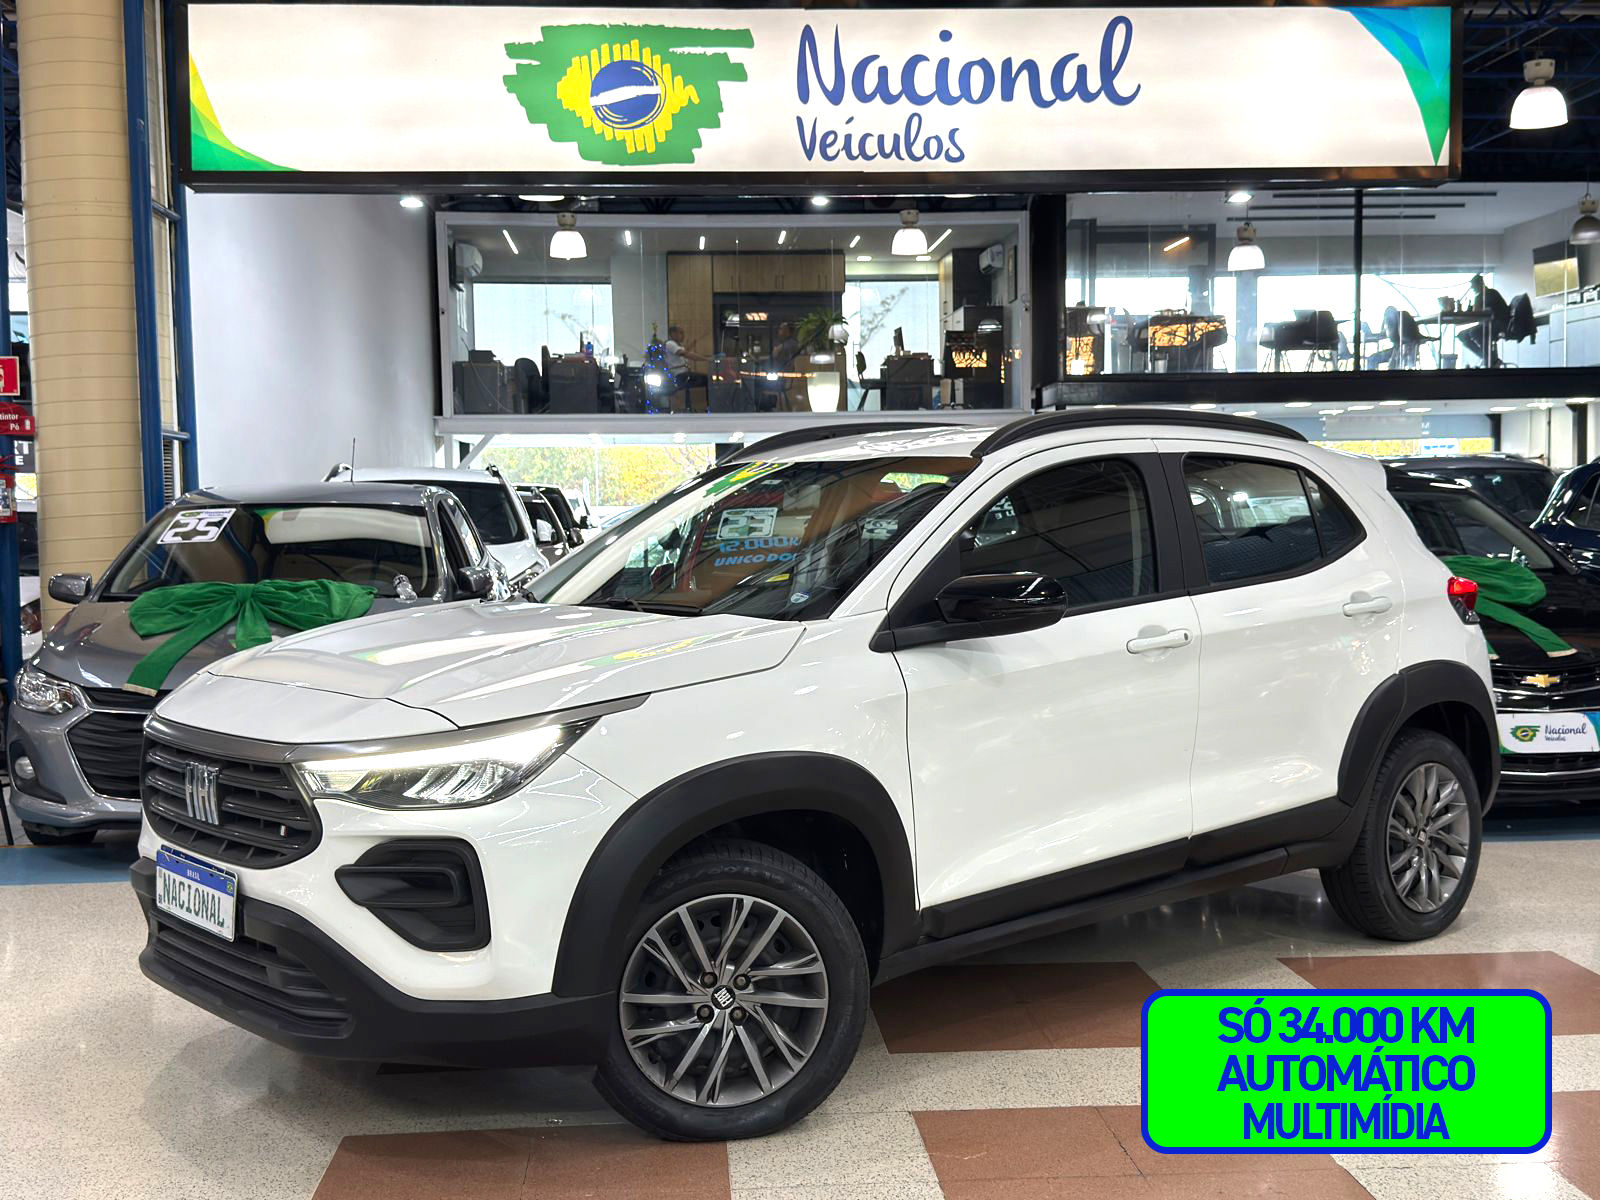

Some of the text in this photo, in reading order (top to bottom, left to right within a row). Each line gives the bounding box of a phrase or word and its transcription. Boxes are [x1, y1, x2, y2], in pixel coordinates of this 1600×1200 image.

[797, 15, 1141, 109] Nacional
[796, 112, 965, 163] Veículos
[162, 517, 224, 541] 25
[720, 515, 773, 538] 23
[1544, 723, 1588, 735] Nacional
[163, 871, 225, 929] NACIONAL
